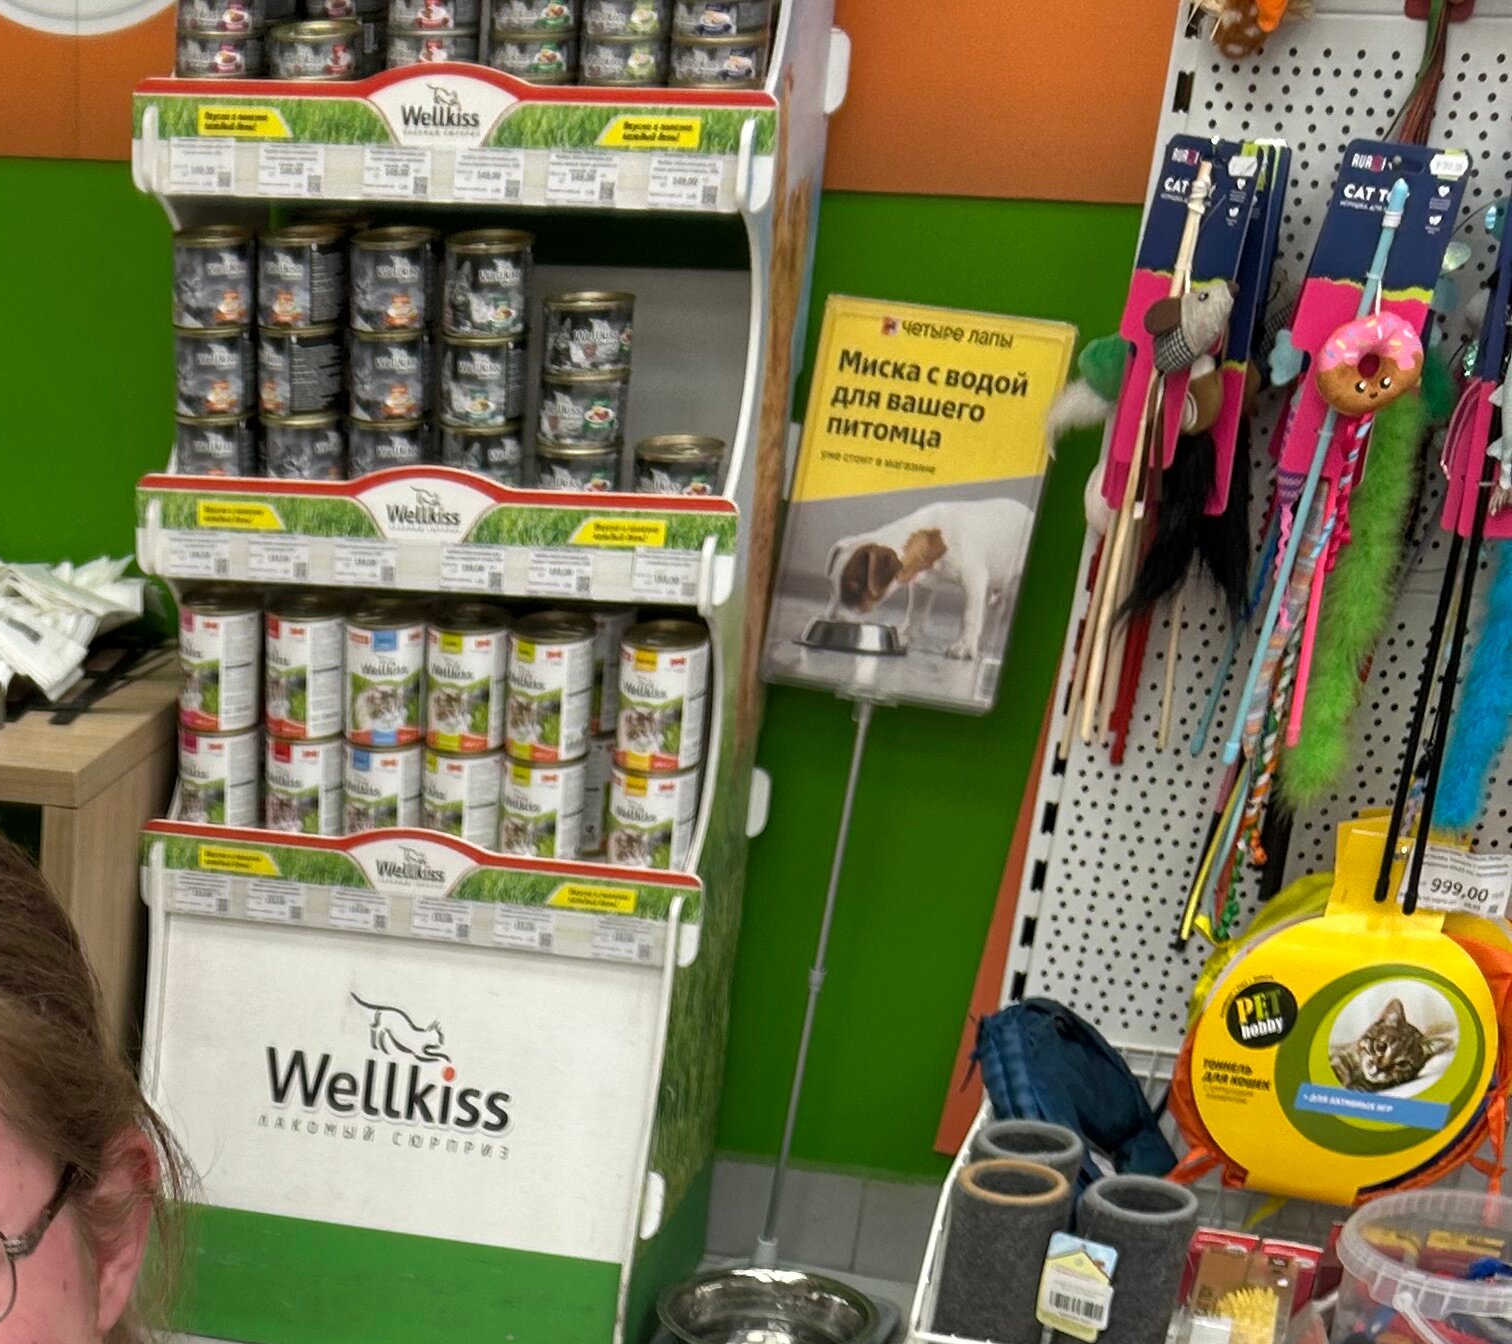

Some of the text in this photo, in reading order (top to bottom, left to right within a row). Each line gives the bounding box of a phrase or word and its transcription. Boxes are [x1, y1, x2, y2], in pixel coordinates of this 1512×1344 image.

[401, 104, 479, 129] Wellkiss
[1343, 183, 1376, 201] CAT
[901, 318, 1015, 350] четыре лапы
[837, 348, 1030, 399] Миска с водой
[830, 383, 986, 424] для вашего
[826, 415, 942, 451] питомца
[386, 503, 460, 526] Wellkiss
[376, 860, 446, 884] Wellkiss
[1430, 878, 1489, 902] 999,00
[1235, 988, 1281, 1025] PET
[1240, 1016, 1285, 1041] hobby
[266, 1047, 512, 1132] Wellkiss
[257, 1114, 511, 1161] ЛАКОМЫЙ СЮРПРИЗ
